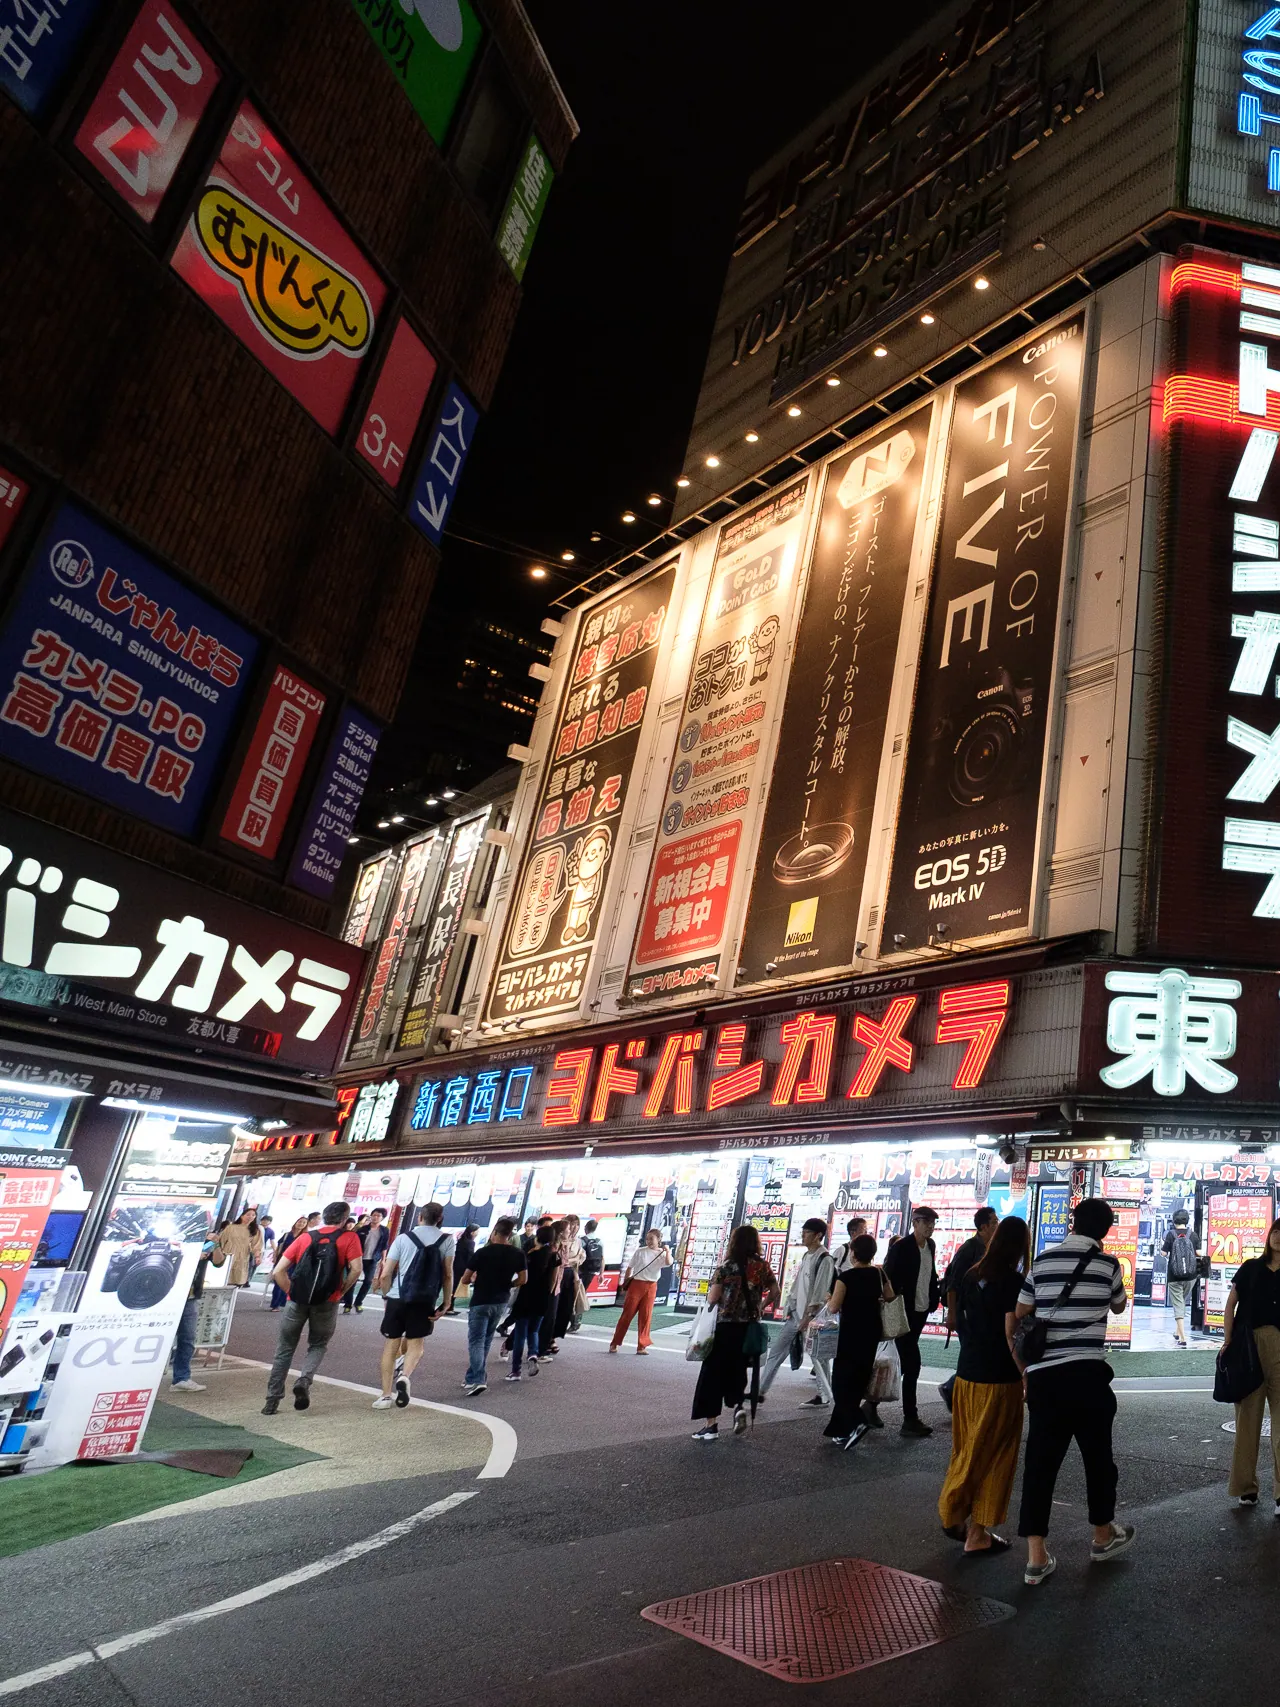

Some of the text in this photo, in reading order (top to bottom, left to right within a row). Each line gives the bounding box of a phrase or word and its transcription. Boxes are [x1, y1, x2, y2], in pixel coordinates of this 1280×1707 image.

[93, 12, 203, 197] アコム
[231, 113, 301, 215] アコム
[211, 204, 359, 340] むじんくん
[1022, 324, 1077, 364] Canon
[362, 413, 404, 471] 3F
[436, 397, 466, 486] 入口
[1006, 362, 1060, 638] POWER OF
[940, 384, 1018, 669] FIVE
[733, 556, 772, 589] GOLD
[96, 567, 243, 688] じゃんぱら
[574, 605, 666, 684] 接客応対
[585, 604, 634, 646] 親切な
[50, 594, 220, 704] JANPARA SHINJYUKU02
[695, 636, 746, 680] ココが
[23, 628, 206, 752] カメラ・PC
[274, 672, 325, 715] パソコン!
[566, 672, 621, 721] 頼れる
[977, 684, 1004, 700] Canon
[0, 671, 195, 803] 高価買取
[348, 721, 378, 752] デジタル
[556, 685, 648, 761] 商品知識
[343, 737, 371, 763] Digital
[242, 701, 303, 845] 高価買取
[547, 759, 598, 800] 豊富な
[318, 813, 351, 840] パソコン
[536, 774, 622, 840] 品揃え
[313, 828, 326, 843] PC
[919, 822, 1010, 854] あなたの写真に新しい力を。
[303, 859, 334, 883] Mobile
[653, 855, 729, 907] 新規会員
[914, 844, 1006, 890] EOS 5D
[929, 881, 985, 911] Mark IV
[655, 897, 713, 940] 募集中
[785, 930, 813, 946] Nikon
[497, 952, 588, 996] ヨドバシカメラ
[74, 992, 104, 1012] West
[107, 1000, 135, 1020] Main
[137, 1009, 168, 1027] Store
[796, 988, 850, 1006] ヨドバシカメラ
[186, 1016, 241, 1045] 友都八喜
[542, 980, 1012, 1128] ヨドバシカメラ
[107, 1080, 163, 1101] カメラ館
[412, 1066, 534, 1130] 新宿西口
[719, 1136, 770, 1150] ヨドバシカメラ
[1142, 1126, 1252, 1141] ヨドバシカメラ
[5, 1181, 48, 1192] 会員様
[1151, 1162, 1270, 1183] ヨドバシカメラ
[847, 1197, 901, 1211] Information
[72, 1335, 164, 1368] α9
[107, 1413, 144, 1429] 火気厳禁
